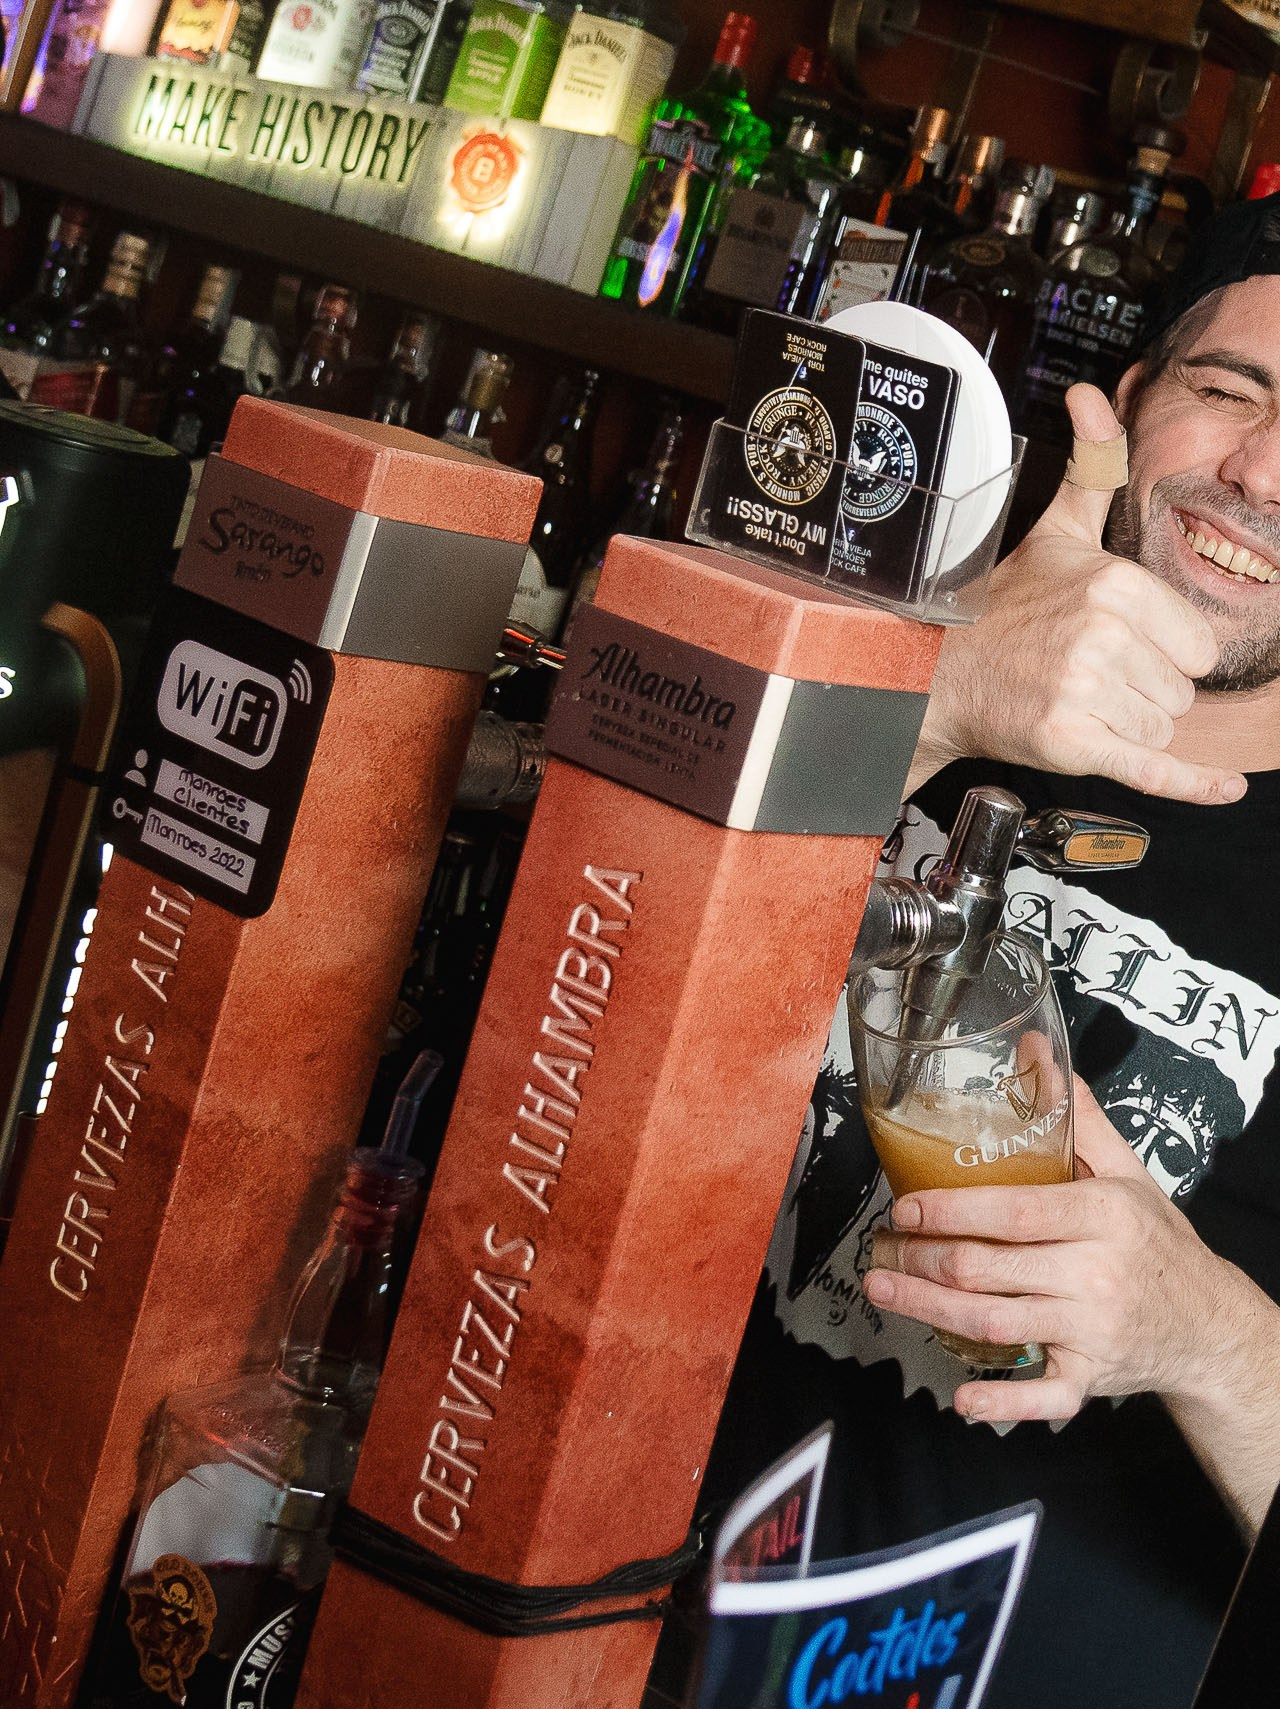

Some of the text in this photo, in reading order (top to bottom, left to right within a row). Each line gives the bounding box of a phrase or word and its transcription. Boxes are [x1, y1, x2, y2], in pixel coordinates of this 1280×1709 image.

[134, 74, 254, 155] MAKE
[250, 94, 429, 183] HISTORY
[786, 332, 827, 353] ROCK CAFE
[868, 375, 926, 411] VASO
[884, 363, 929, 389] quites
[763, 405, 798, 434] GRUNGE
[747, 443, 760, 468] PUB
[759, 443, 781, 480] ROCK
[877, 428, 900, 466] ROCK
[900, 442, 915, 467] PUB
[789, 458, 819, 487] HEAVY
[805, 466, 828, 497] MUSIC
[727, 496, 827, 547] MY GLASS!!
[744, 522, 806, 556] Don't take
[844, 562, 867, 576] CAFE
[175, 662, 276, 747] WiFi
[583, 642, 737, 731] Alhambra
[638, 708, 727, 752] SINGULAR
[173, 788, 251, 835] Clientes
[209, 846, 245, 878] 2022
[953, 1092, 1071, 1168] GUINNESS
[48, 1011, 156, 1303] CERVEZAS
[411, 863, 644, 1543] CERVEZAS ALHAMBRA
